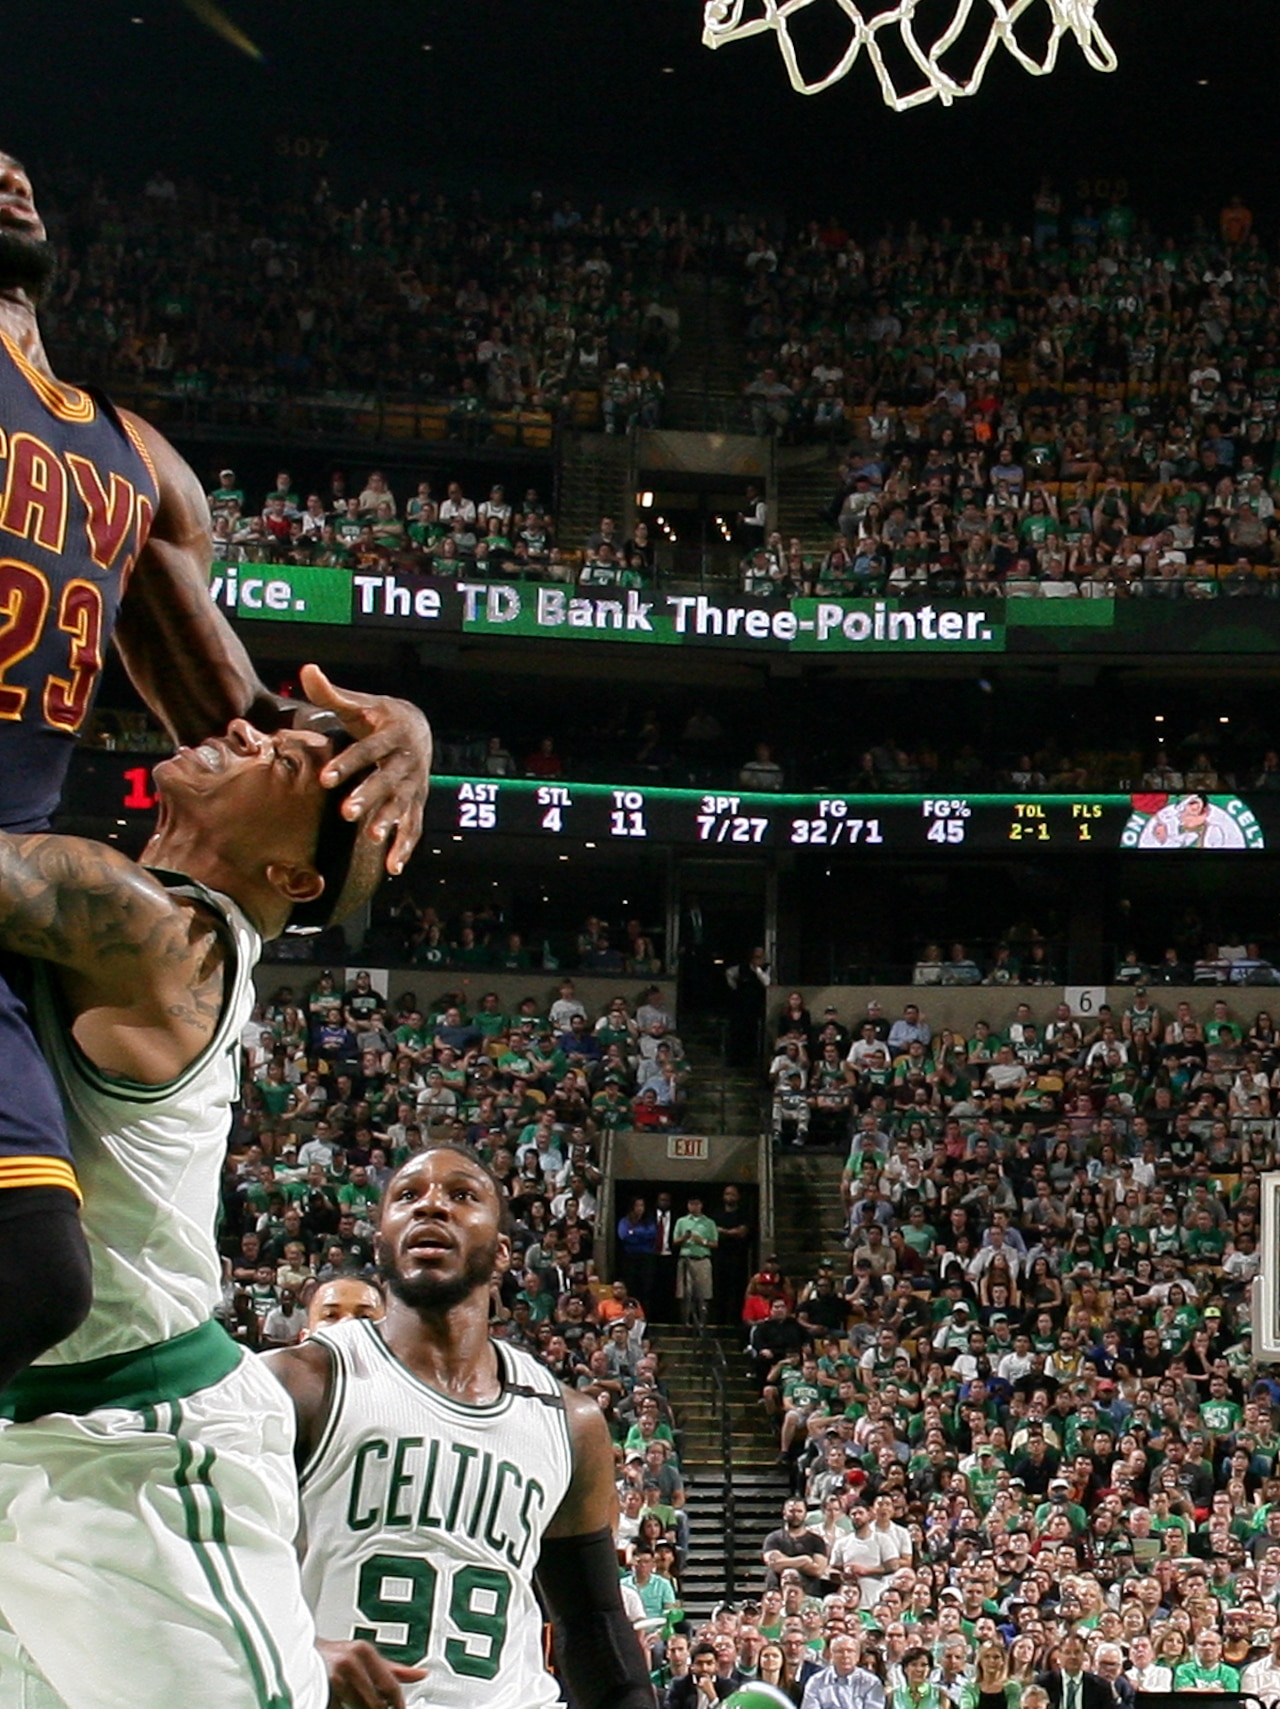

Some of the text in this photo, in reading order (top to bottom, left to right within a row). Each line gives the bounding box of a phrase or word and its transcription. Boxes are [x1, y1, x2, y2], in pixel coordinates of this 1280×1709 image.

[275, 137, 329, 158] 307
[354, 575, 442, 618] The
[456, 582, 521, 623] TD
[536, 586, 654, 631] Bank
[666, 595, 993, 641] Three-Pointer.
[458, 783, 499, 801] AST
[537, 787, 572, 806] STL
[612, 791, 643, 809] TO
[701, 796, 740, 815] 3PT
[819, 800, 847, 817] FG
[923, 800, 971, 818] FG%
[1014, 804, 1046, 818] TOL
[1072, 804, 1102, 818] FLS
[459, 803, 496, 829] 25
[542, 807, 562, 832] 4
[611, 811, 646, 837] 11
[697, 815, 768, 843] 7/27
[791, 819, 883, 845] 32/71
[927, 819, 965, 844] 45
[1009, 823, 1050, 841] 2-1
[1079, 823, 1091, 841] 1
[1079, 990, 1092, 1013] 6
[675, 1138, 702, 1156] EXIT
[348, 1437, 545, 1569] CELTICS
[352, 1553, 515, 1682] 99
